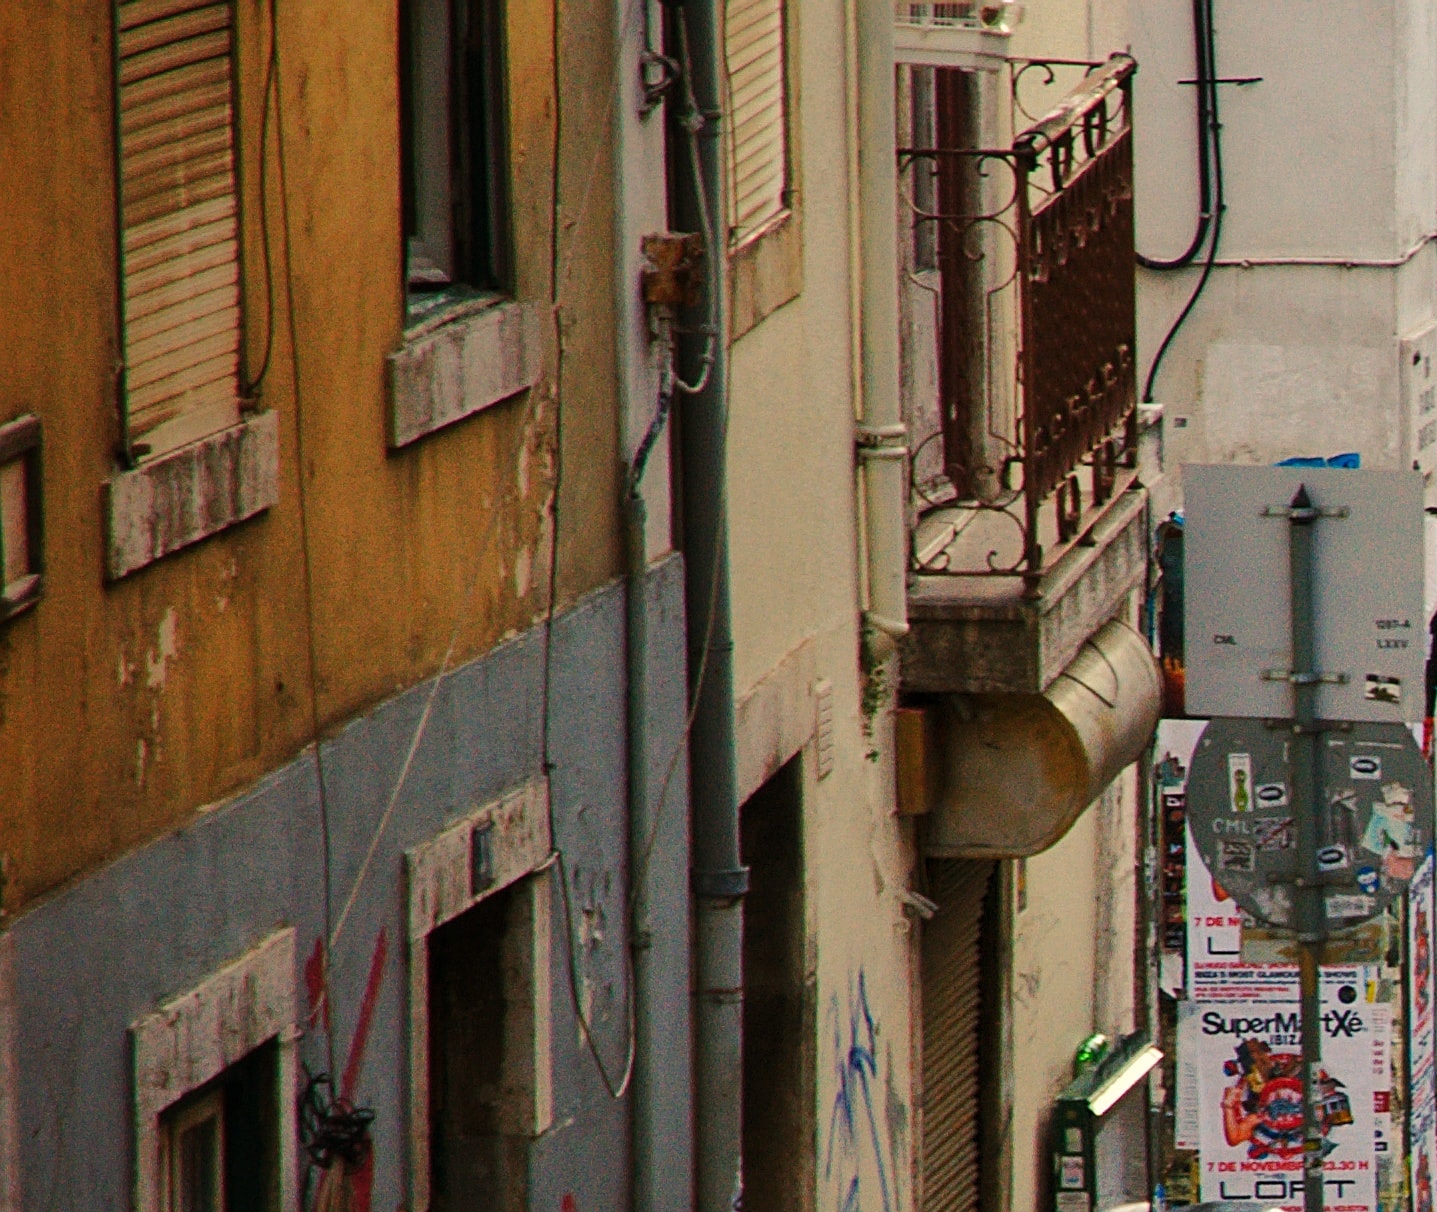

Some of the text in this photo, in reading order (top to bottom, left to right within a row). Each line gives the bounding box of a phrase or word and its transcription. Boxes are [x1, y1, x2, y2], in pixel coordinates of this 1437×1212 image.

[1202, 1009, 1363, 1037] SuperMtXé
[1207, 1161, 1214, 1172] 7
[1218, 1161, 1237, 1172] DE
[1241, 1161, 1304, 1172] NOVEMBR
[1358, 1161, 1369, 1170] H
